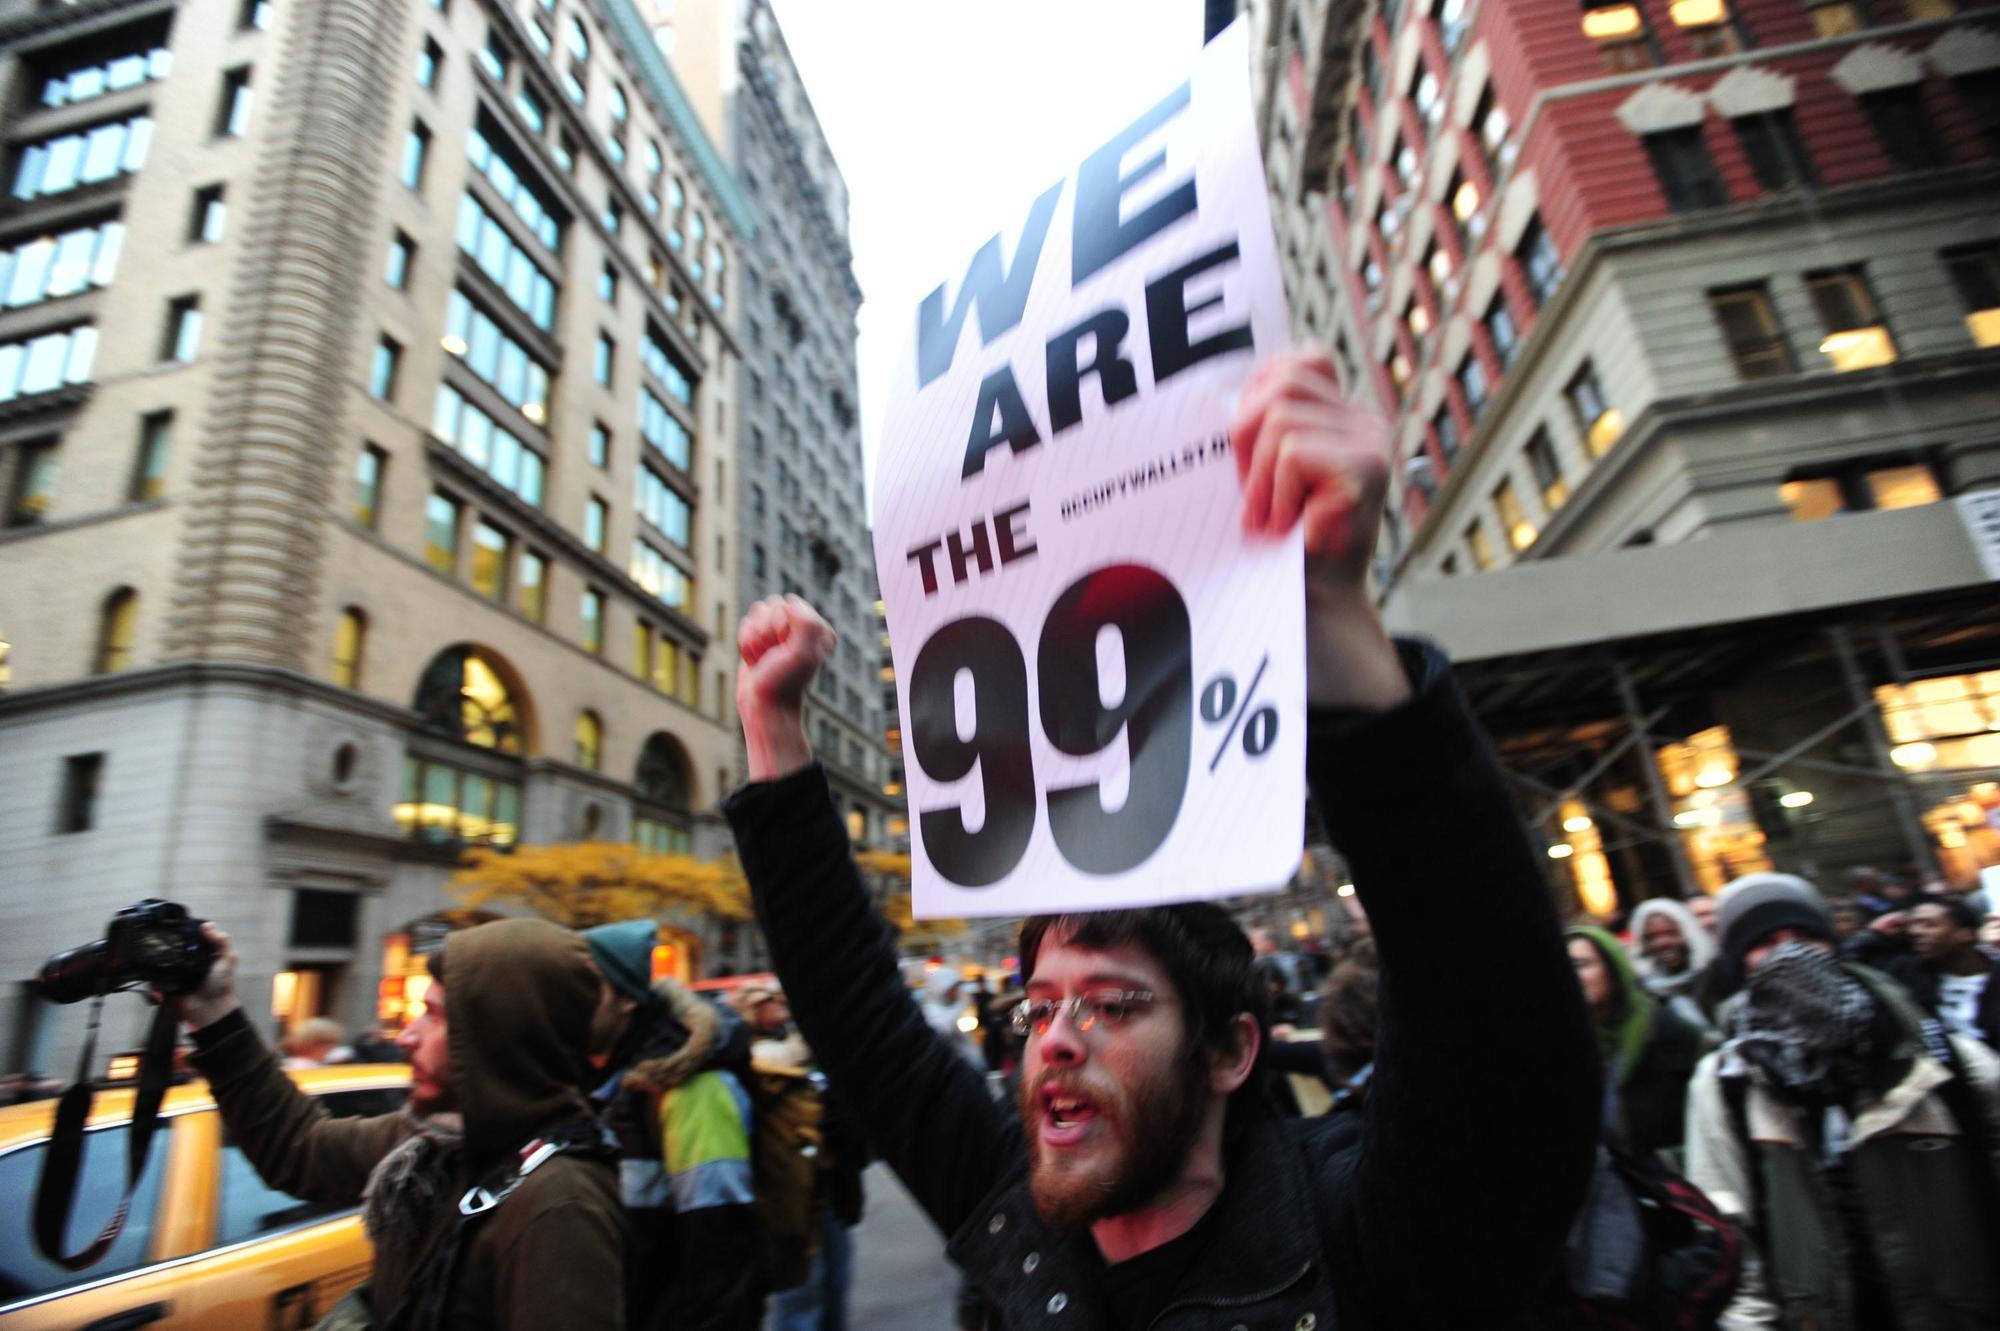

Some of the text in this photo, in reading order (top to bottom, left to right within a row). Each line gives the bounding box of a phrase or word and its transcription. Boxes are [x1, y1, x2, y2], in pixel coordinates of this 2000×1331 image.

[917, 77, 1198, 393] WE
[960, 239, 1255, 484] ARE
[906, 501, 1038, 599] THE
